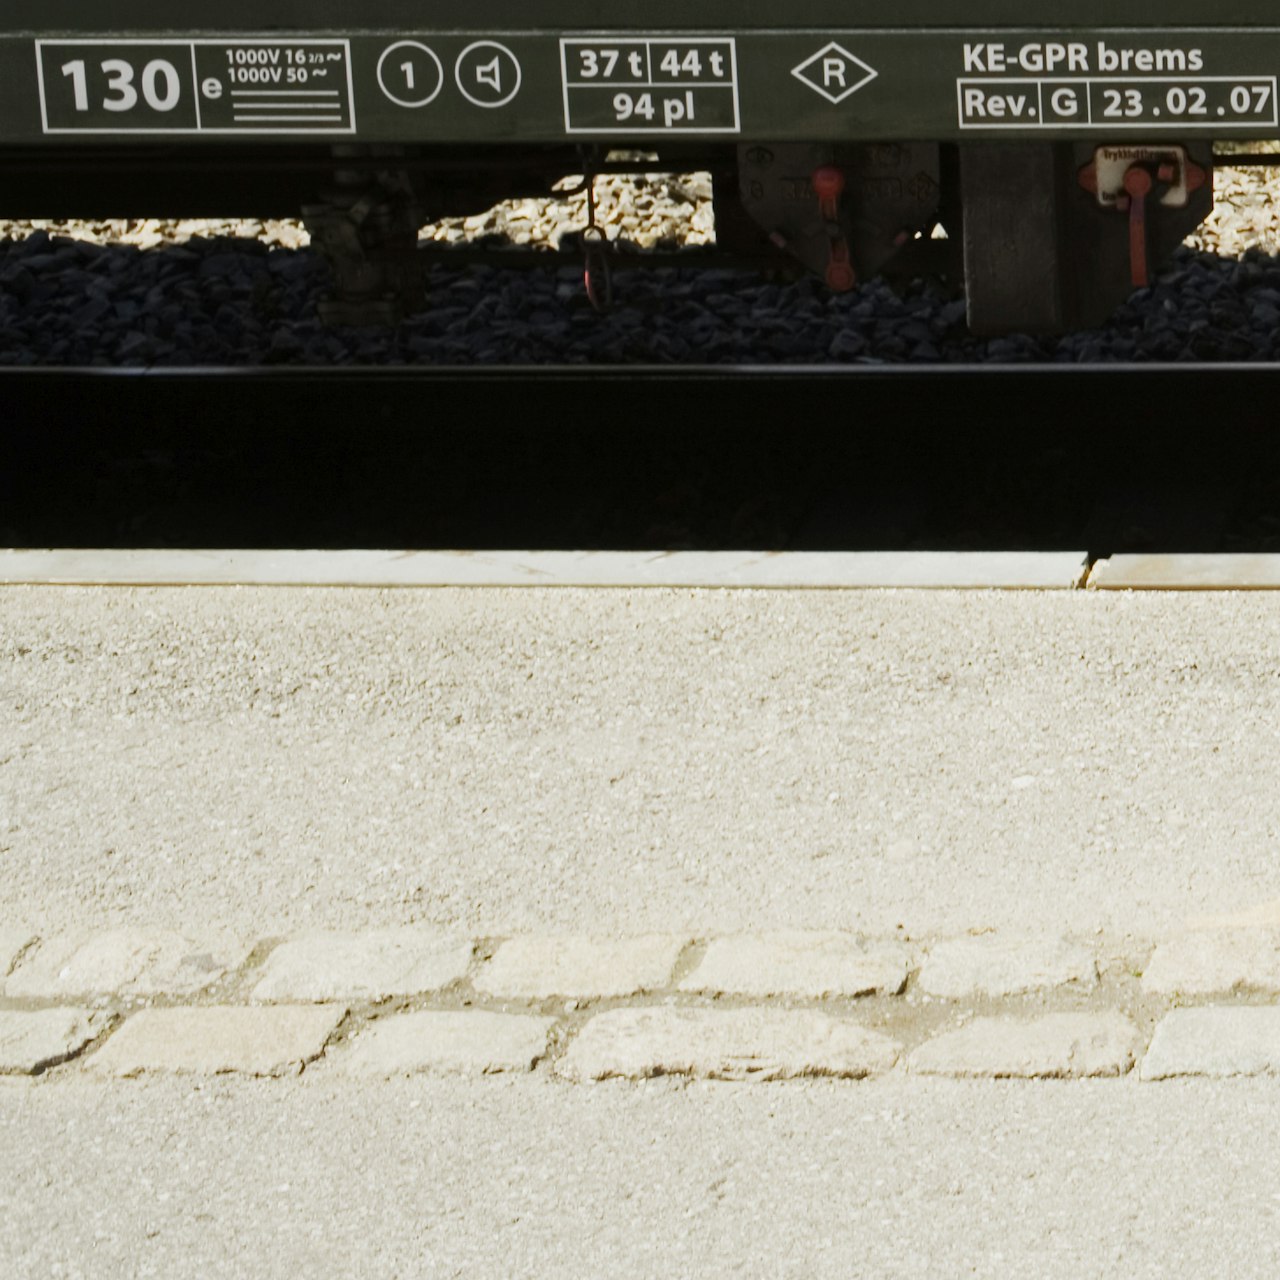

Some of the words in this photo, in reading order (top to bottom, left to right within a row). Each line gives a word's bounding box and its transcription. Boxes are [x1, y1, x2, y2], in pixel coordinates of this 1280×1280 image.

[226, 48, 281, 65] 1000V
[285, 49, 307, 65] 16
[579, 49, 620, 78] 37
[627, 51, 643, 78] t
[660, 49, 703, 77] 44
[708, 50, 724, 77] t
[963, 42, 1090, 72] KE-GPR
[1097, 41, 1204, 72] brems
[61, 59, 181, 112] 130
[227, 66, 283, 83] 1000V
[286, 67, 308, 83] 50
[400, 61, 415, 89] 1
[823, 57, 846, 87] R
[201, 77, 223, 99] e
[964, 88, 1037, 117] Rev.
[1050, 87, 1078, 117] G
[612, 92, 655, 121] 94
[663, 90, 695, 128] pl
